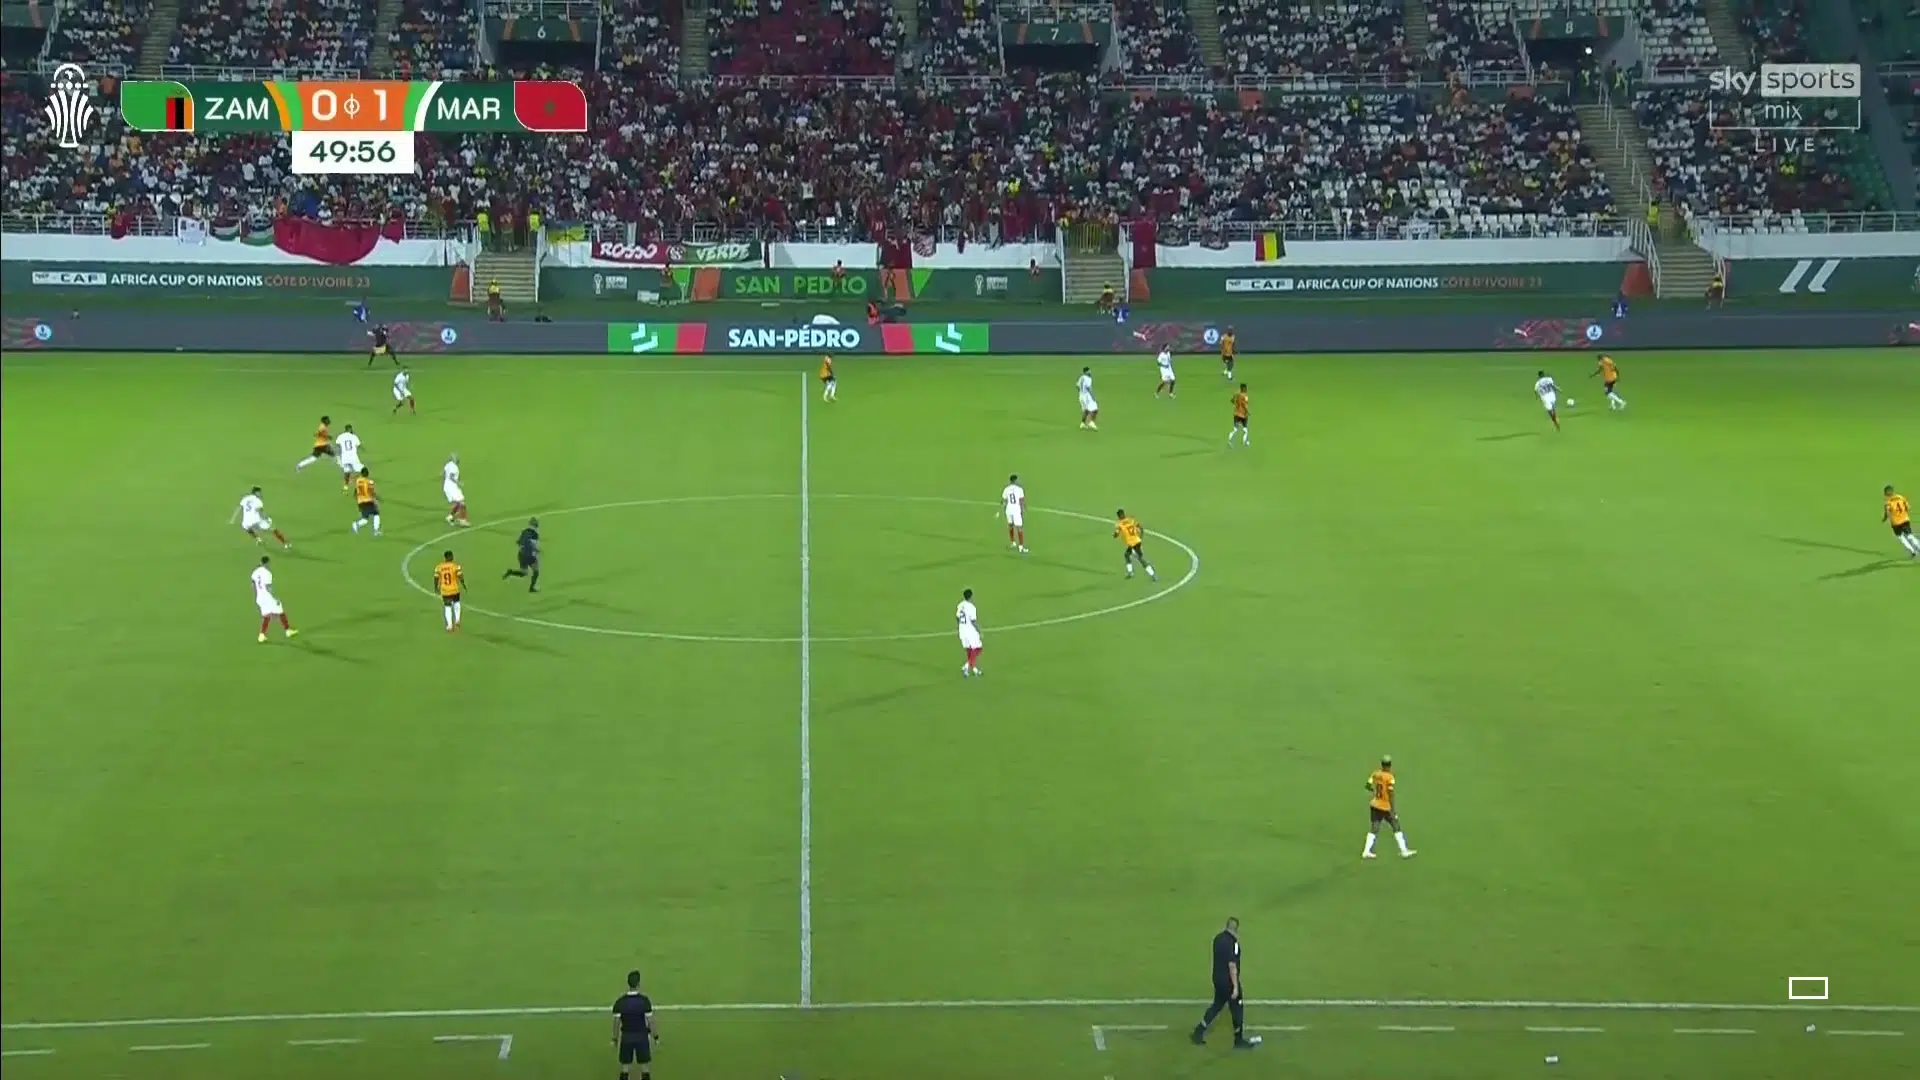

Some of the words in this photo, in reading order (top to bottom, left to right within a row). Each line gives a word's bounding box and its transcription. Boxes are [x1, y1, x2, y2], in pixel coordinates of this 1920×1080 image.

[537, 25, 546, 39] 6
[1050, 27, 1060, 41] 7
[1565, 21, 1574, 34] 8
[599, 242, 658, 259] ROSSO
[695, 243, 751, 261] VERDE
[111, 273, 158, 286] AFRICA
[159, 274, 186, 286] CUP
[187, 274, 205, 286] OF
[207, 275, 264, 287] NATIONS
[356, 276, 371, 288] 23
[735, 275, 781, 294] SAN
[1296, 279, 1341, 290] AFRICA
[1342, 278, 1366, 290] CUP
[1367, 278, 1385, 290] OF
[1386, 277, 1439, 289] NATIONS
[728, 323, 861, 348] SAN-PÉDRO
[443, 573, 453, 586] 9
